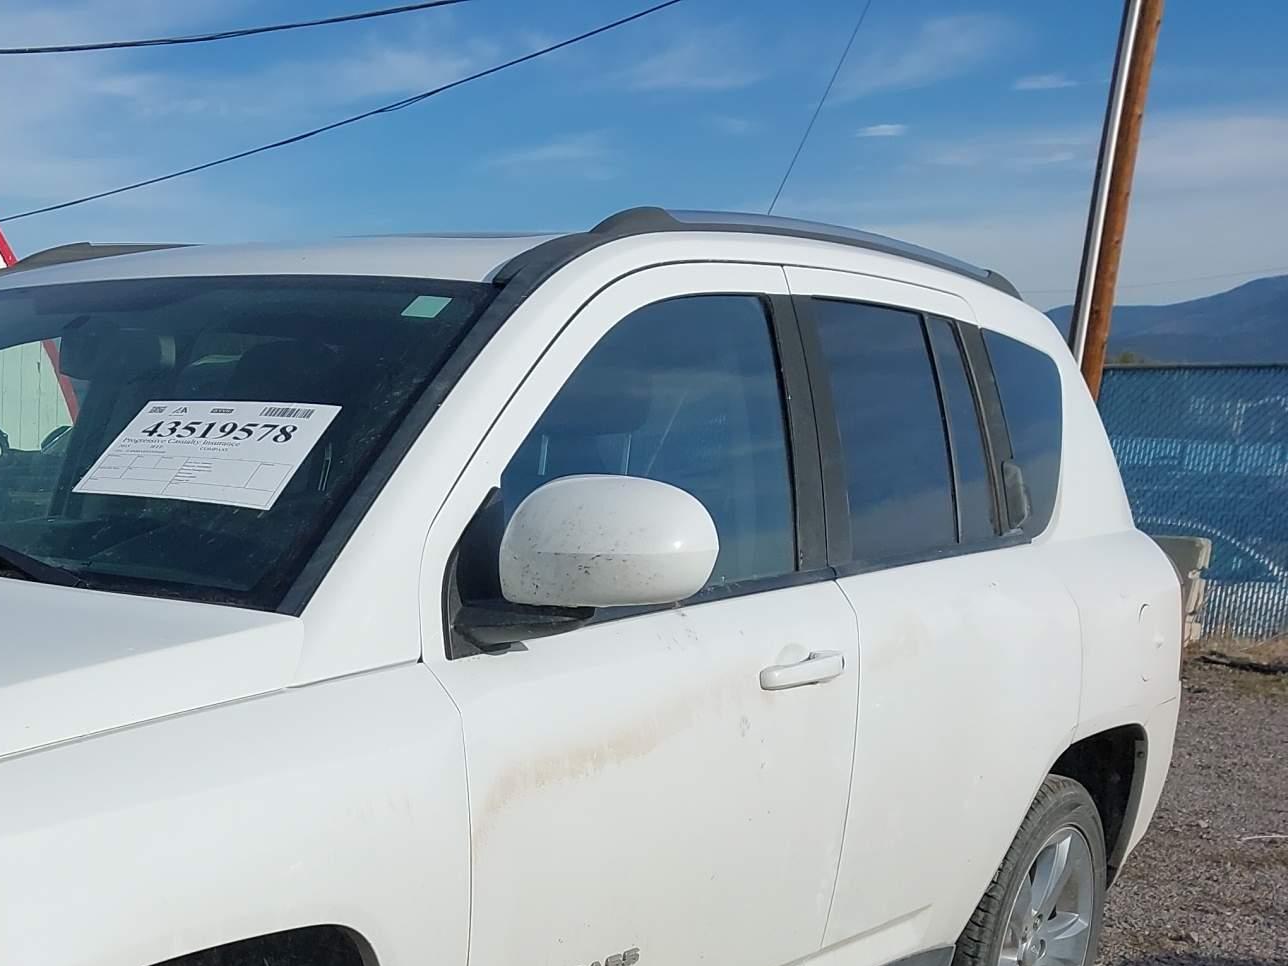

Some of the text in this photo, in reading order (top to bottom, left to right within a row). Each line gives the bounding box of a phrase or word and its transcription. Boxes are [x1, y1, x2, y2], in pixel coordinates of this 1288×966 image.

[141, 420, 298, 443] 43519578
[122, 437, 241, 448] Progressive Casualty Insurance
